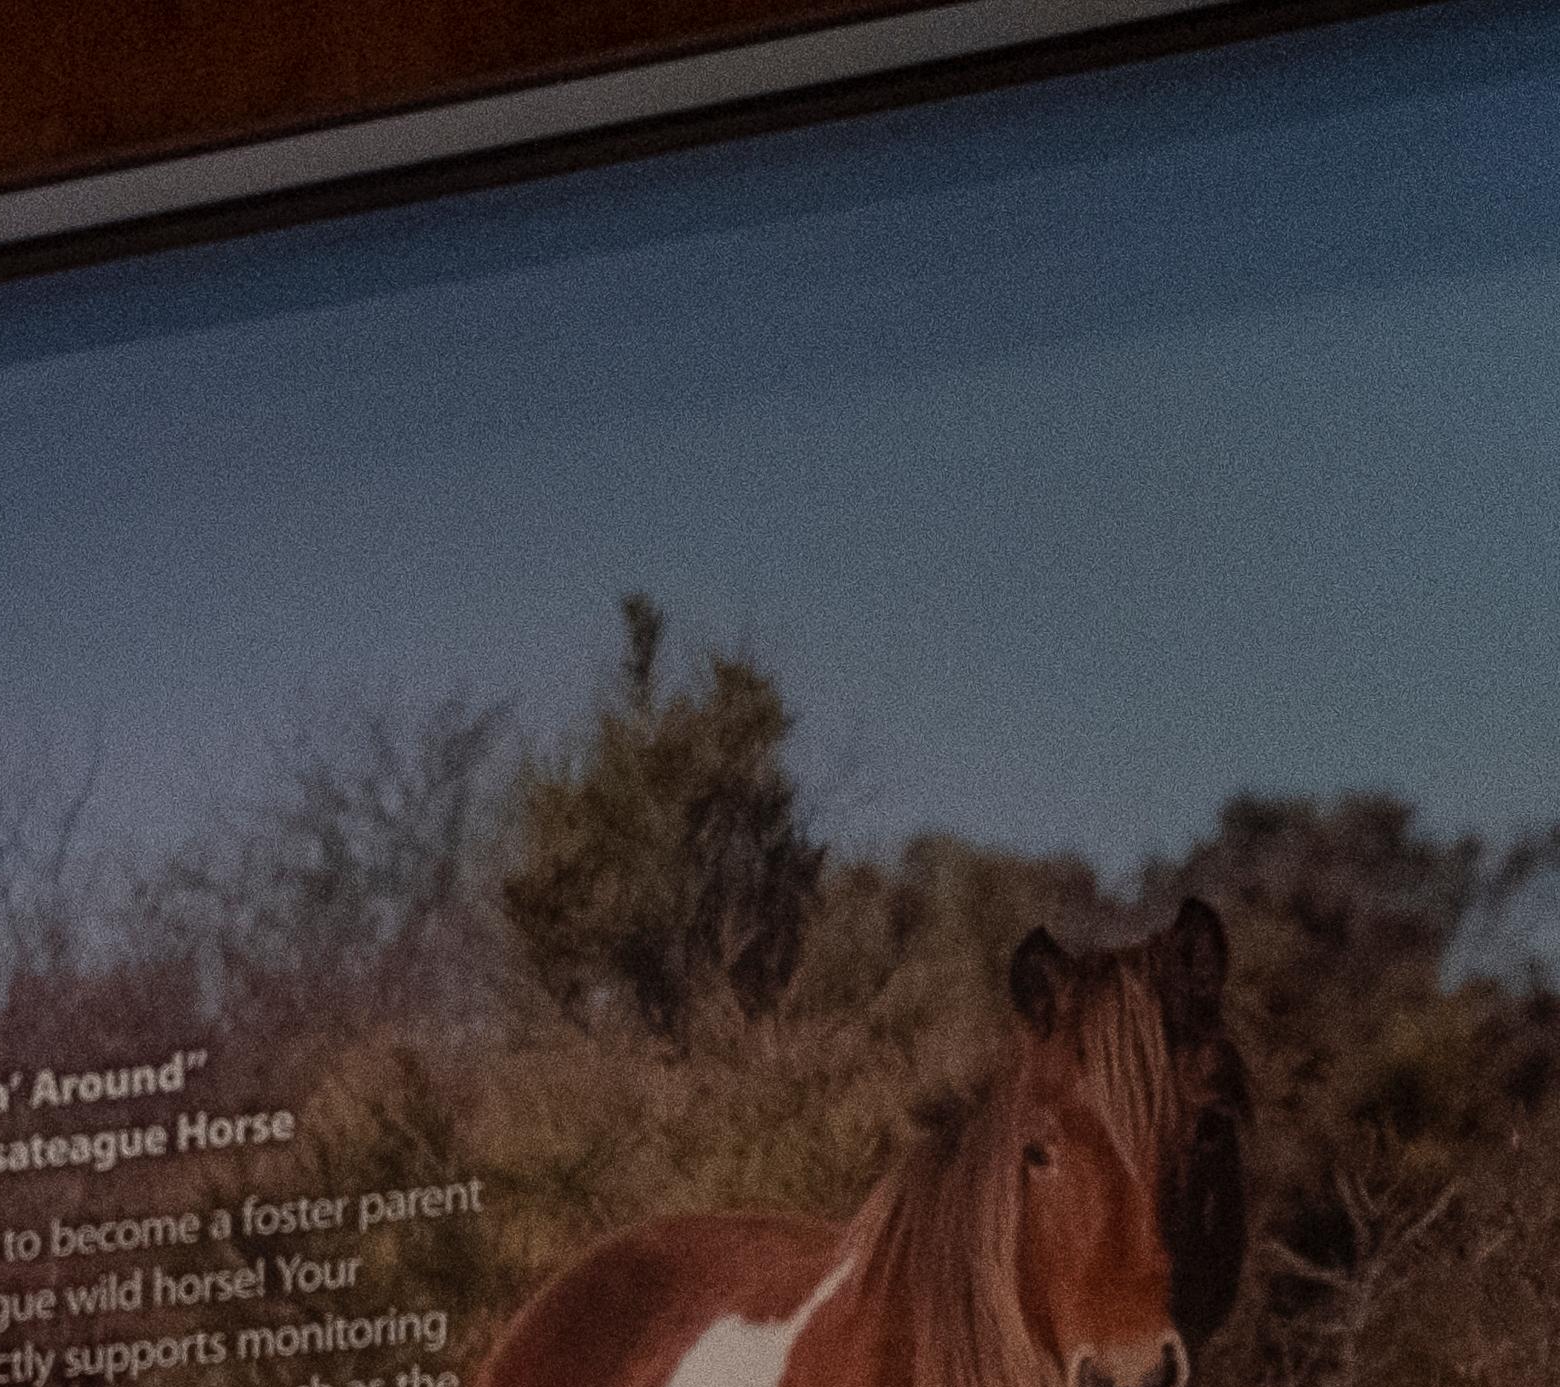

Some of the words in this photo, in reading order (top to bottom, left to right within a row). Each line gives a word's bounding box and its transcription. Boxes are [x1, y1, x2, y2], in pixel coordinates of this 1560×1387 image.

[29, 1048, 205, 1109] Around”
[176, 1109, 293, 1153] Horse
[3, 1228, 43, 1263] to
[49, 1213, 200, 1258] become
[211, 1208, 231, 1239] a
[241, 1195, 350, 1237] foster
[358, 1176, 484, 1234] parent
[65, 1269, 144, 1316] wild
[152, 1257, 266, 1307] horse!
[275, 1254, 362, 1294] Your
[65, 1330, 227, 1385] supports
[237, 1308, 448, 1360] monitoring
